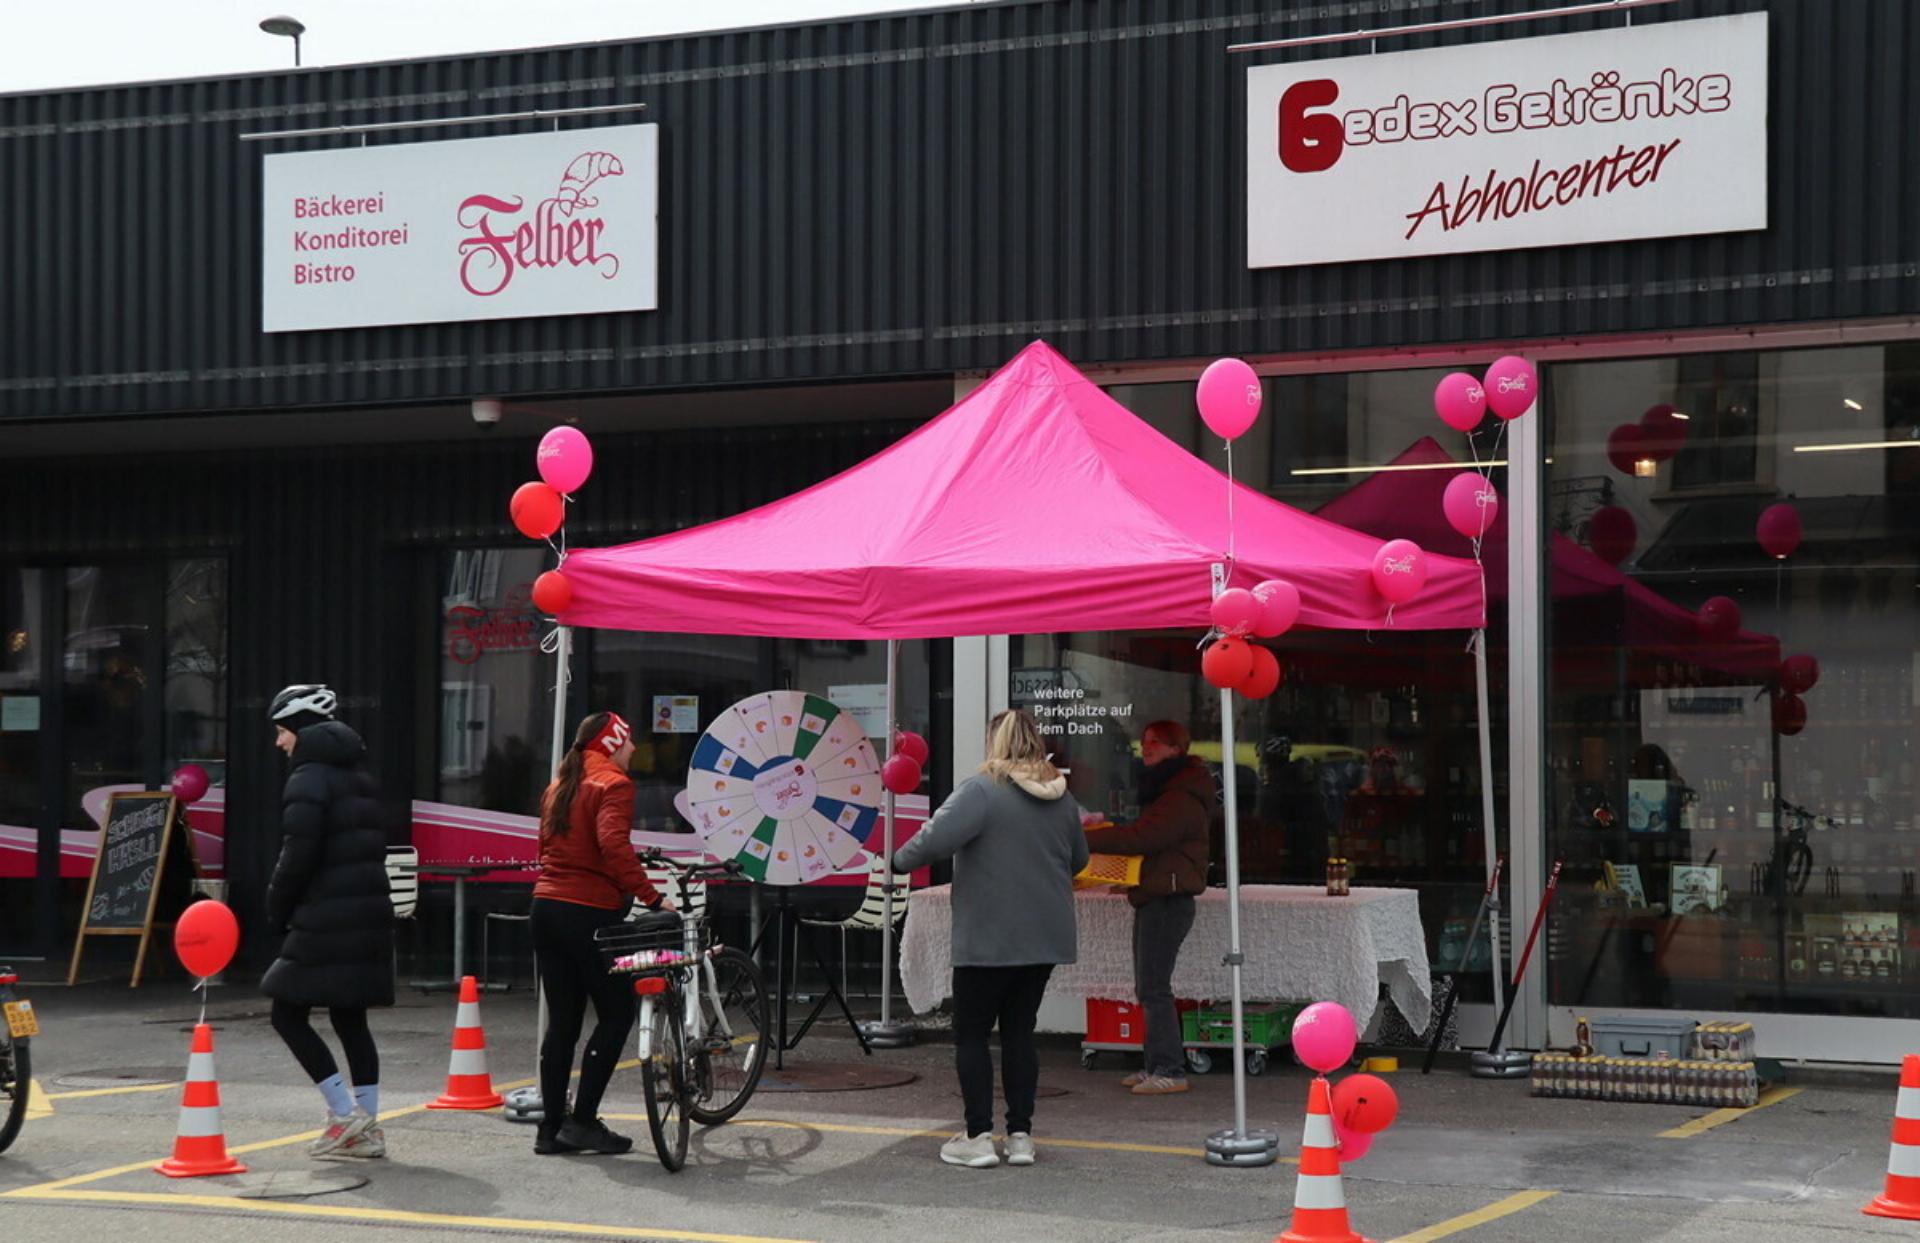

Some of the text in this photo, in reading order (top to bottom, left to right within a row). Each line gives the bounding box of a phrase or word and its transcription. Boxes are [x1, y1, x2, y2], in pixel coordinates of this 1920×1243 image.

[1484, 68, 1731, 133] Getränke
[1405, 138, 1680, 240] Abholcenter
[293, 192, 384, 219] Bäckerei
[293, 223, 409, 251] Konditorei
[457, 194, 619, 296] Felber
[293, 264, 355, 285] Bistro
[1034, 687, 1084, 699] weitere
[1034, 704, 1133, 719] Parkplätze auf
[1068, 722, 1103, 734] Dach
